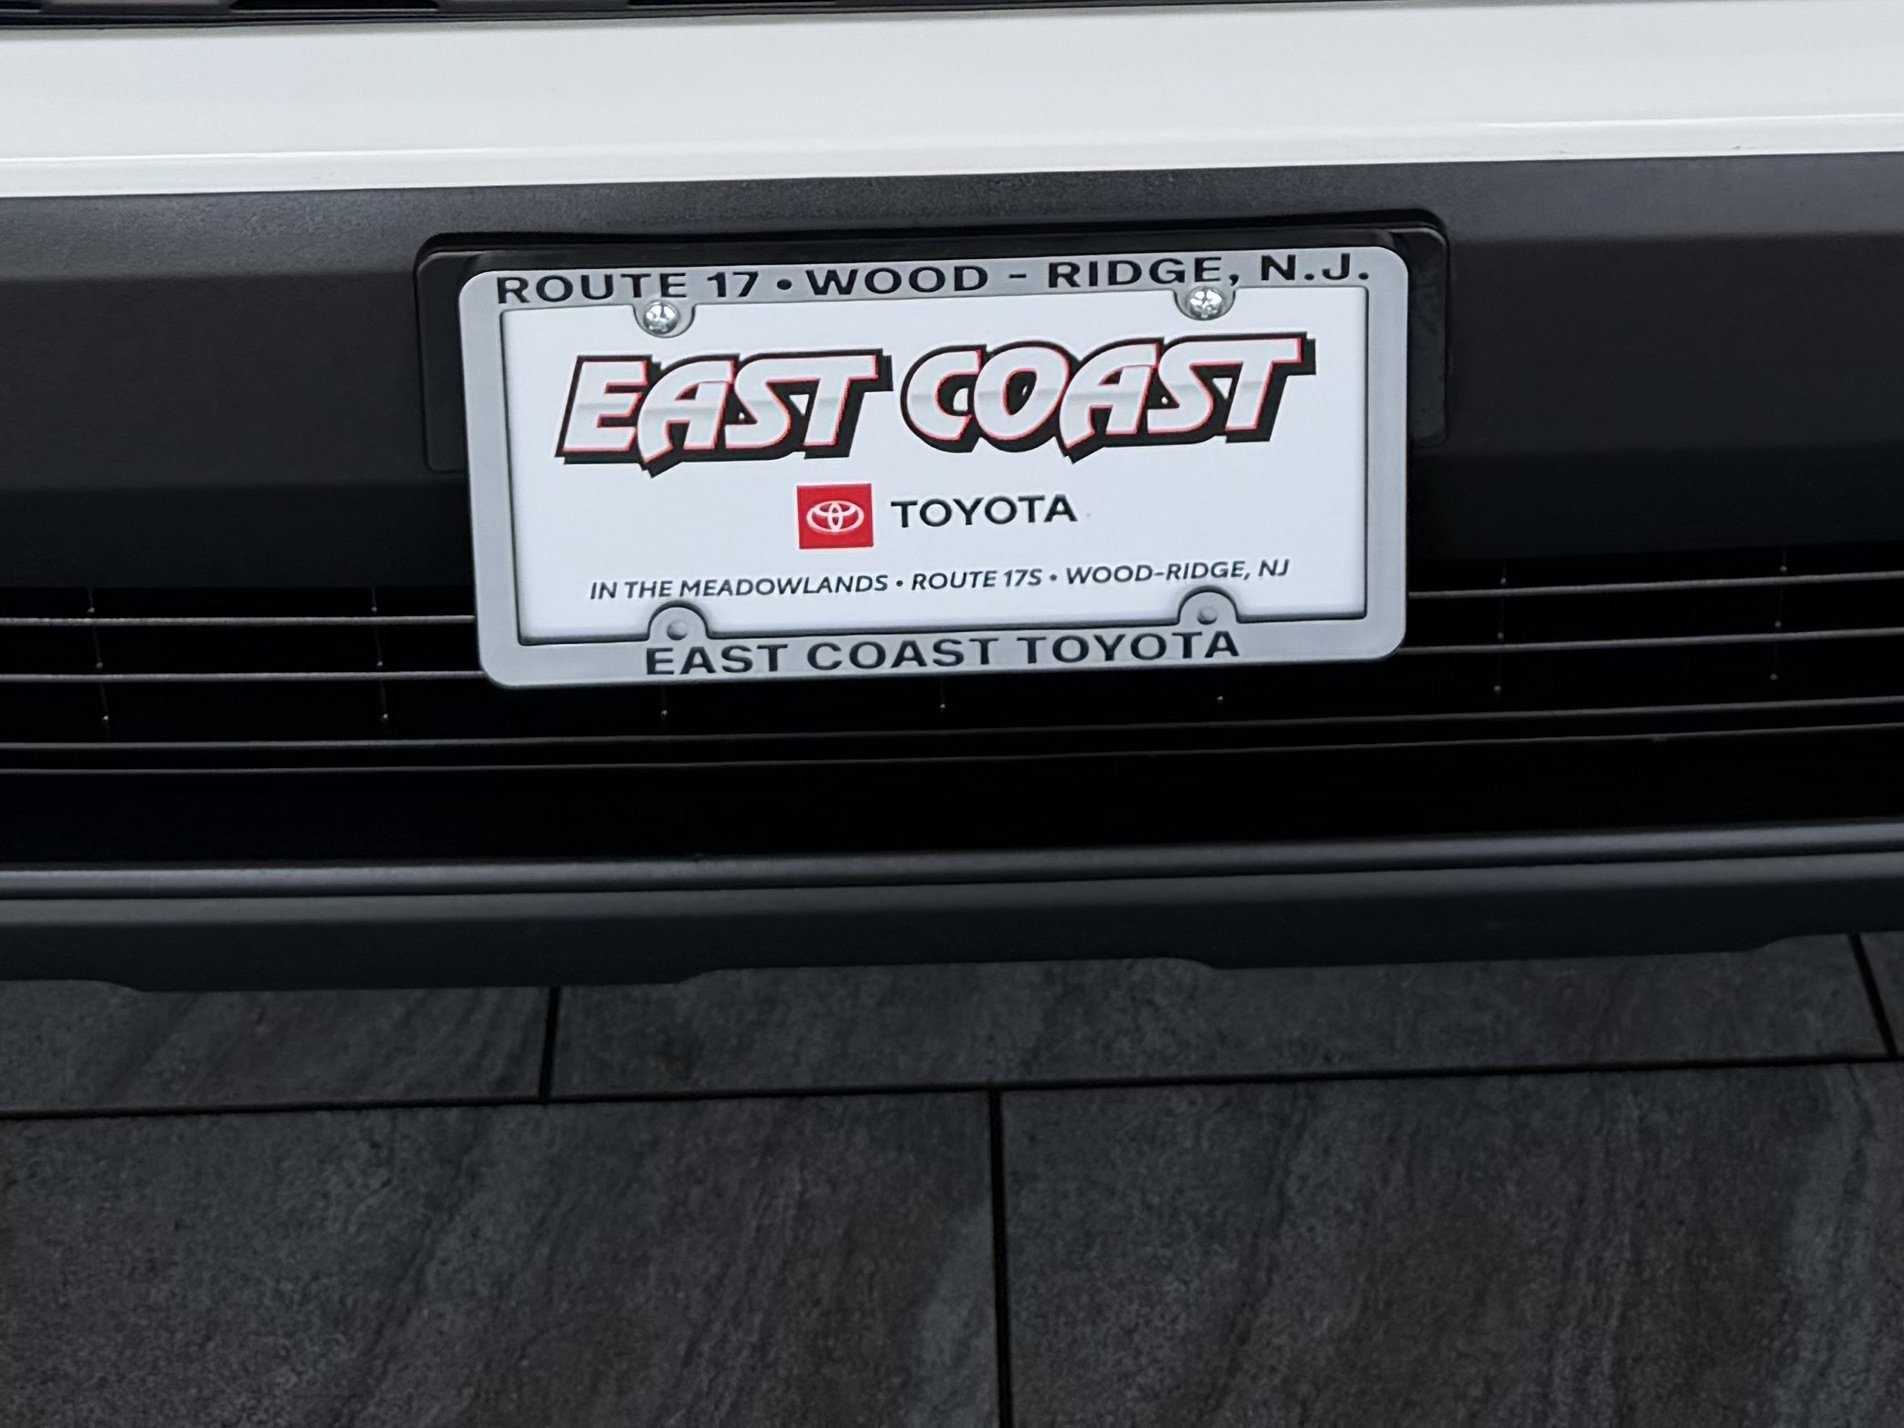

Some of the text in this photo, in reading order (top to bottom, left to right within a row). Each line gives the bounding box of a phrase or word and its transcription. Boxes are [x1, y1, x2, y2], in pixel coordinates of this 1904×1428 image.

[496, 271, 687, 304] ROUTE
[706, 270, 759, 298] 17
[805, 264, 989, 296] WOOD
[1047, 256, 1241, 289] RIDGE,
[1260, 252, 1370, 282] N.J.
[555, 331, 1316, 478] EAST COAST
[890, 494, 1078, 528] TOYOTA
[590, 558, 1290, 600] IN THE MEADOWLANDS ROUTE 17S WOOD-RIDGE, NJ
[645, 630, 1240, 676] EAST COAST TOYOTA
